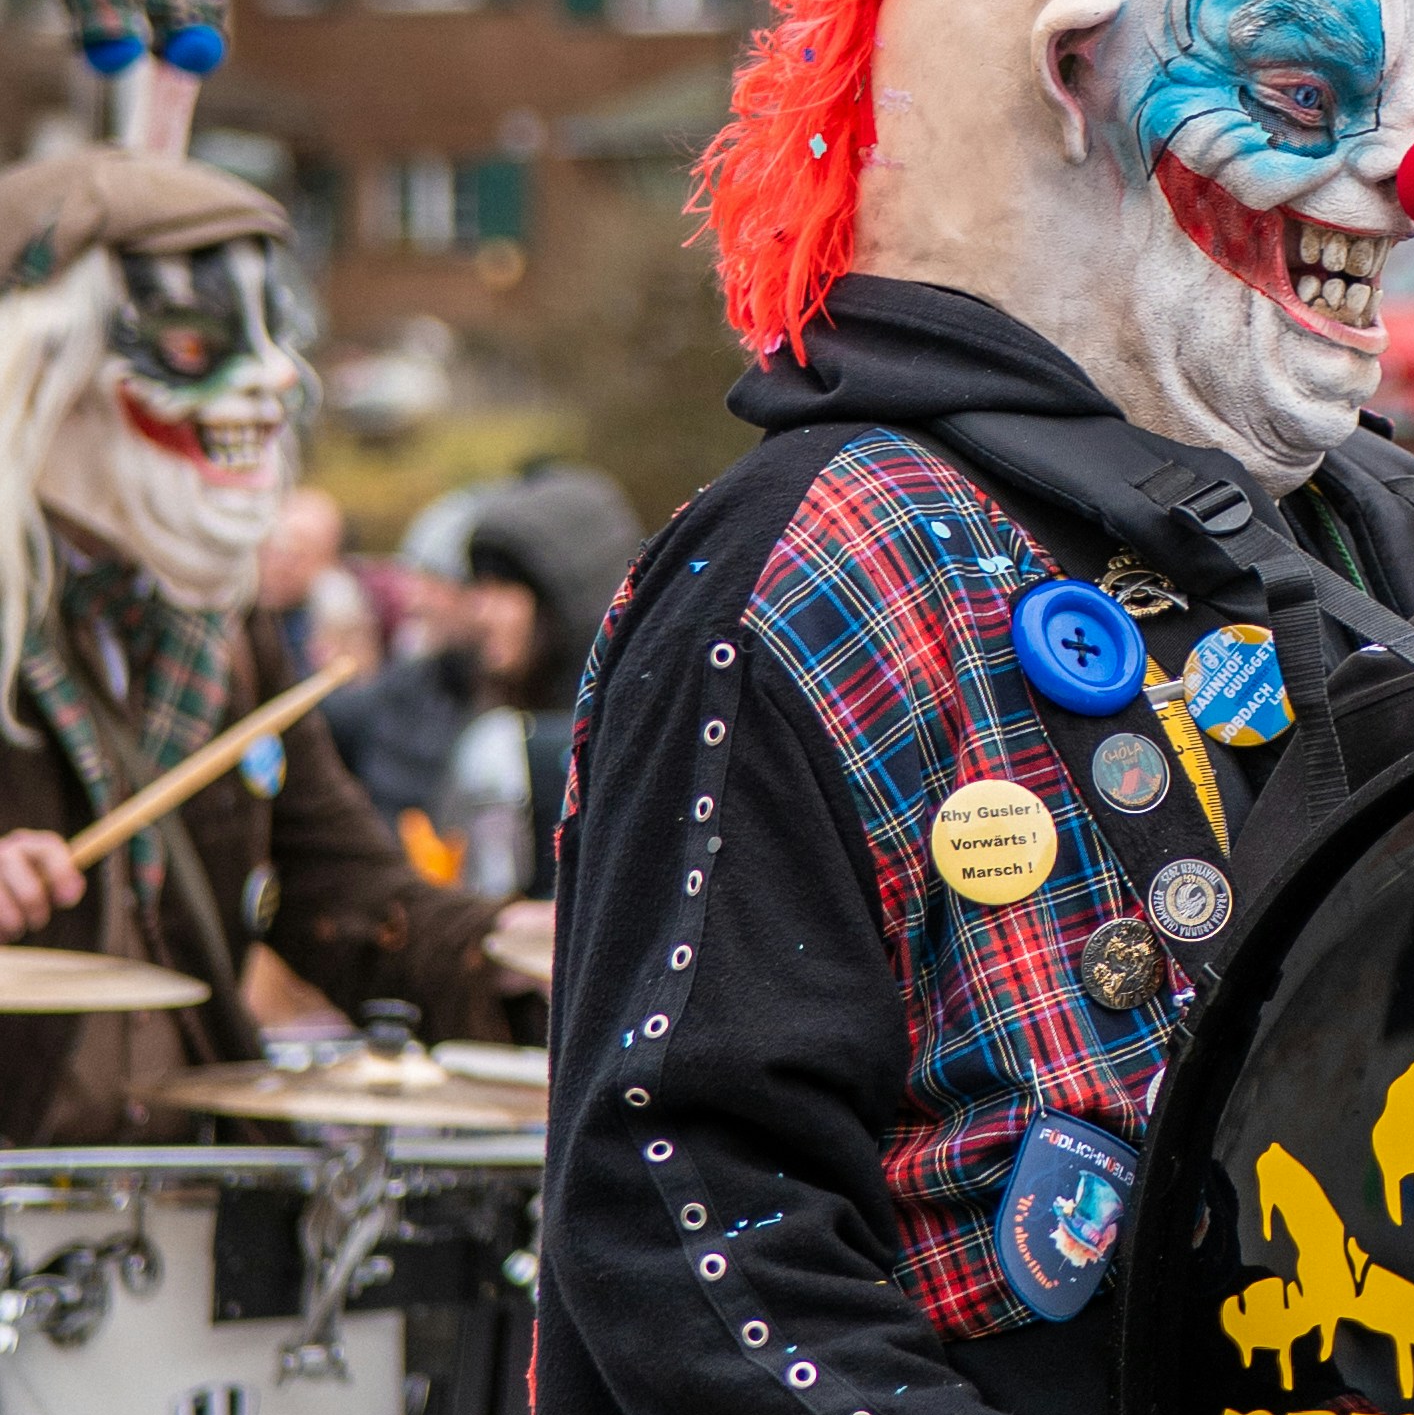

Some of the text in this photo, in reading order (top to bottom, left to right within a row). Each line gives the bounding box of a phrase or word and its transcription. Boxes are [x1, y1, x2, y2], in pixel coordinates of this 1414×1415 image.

[1223, 636, 1275, 698] GUUGGET
[1188, 651, 1243, 718] BAHNHOF
[1221, 683, 1273, 744] JOBDACH
[941, 809, 971, 823] Rhy
[977, 804, 1031, 819] Gusler
[950, 834, 1027, 851] Vorwärts
[962, 863, 1022, 880] Marsch
[1161, 866, 1180, 884] 2025
[1181, 863, 1220, 885] THAYNGEN
